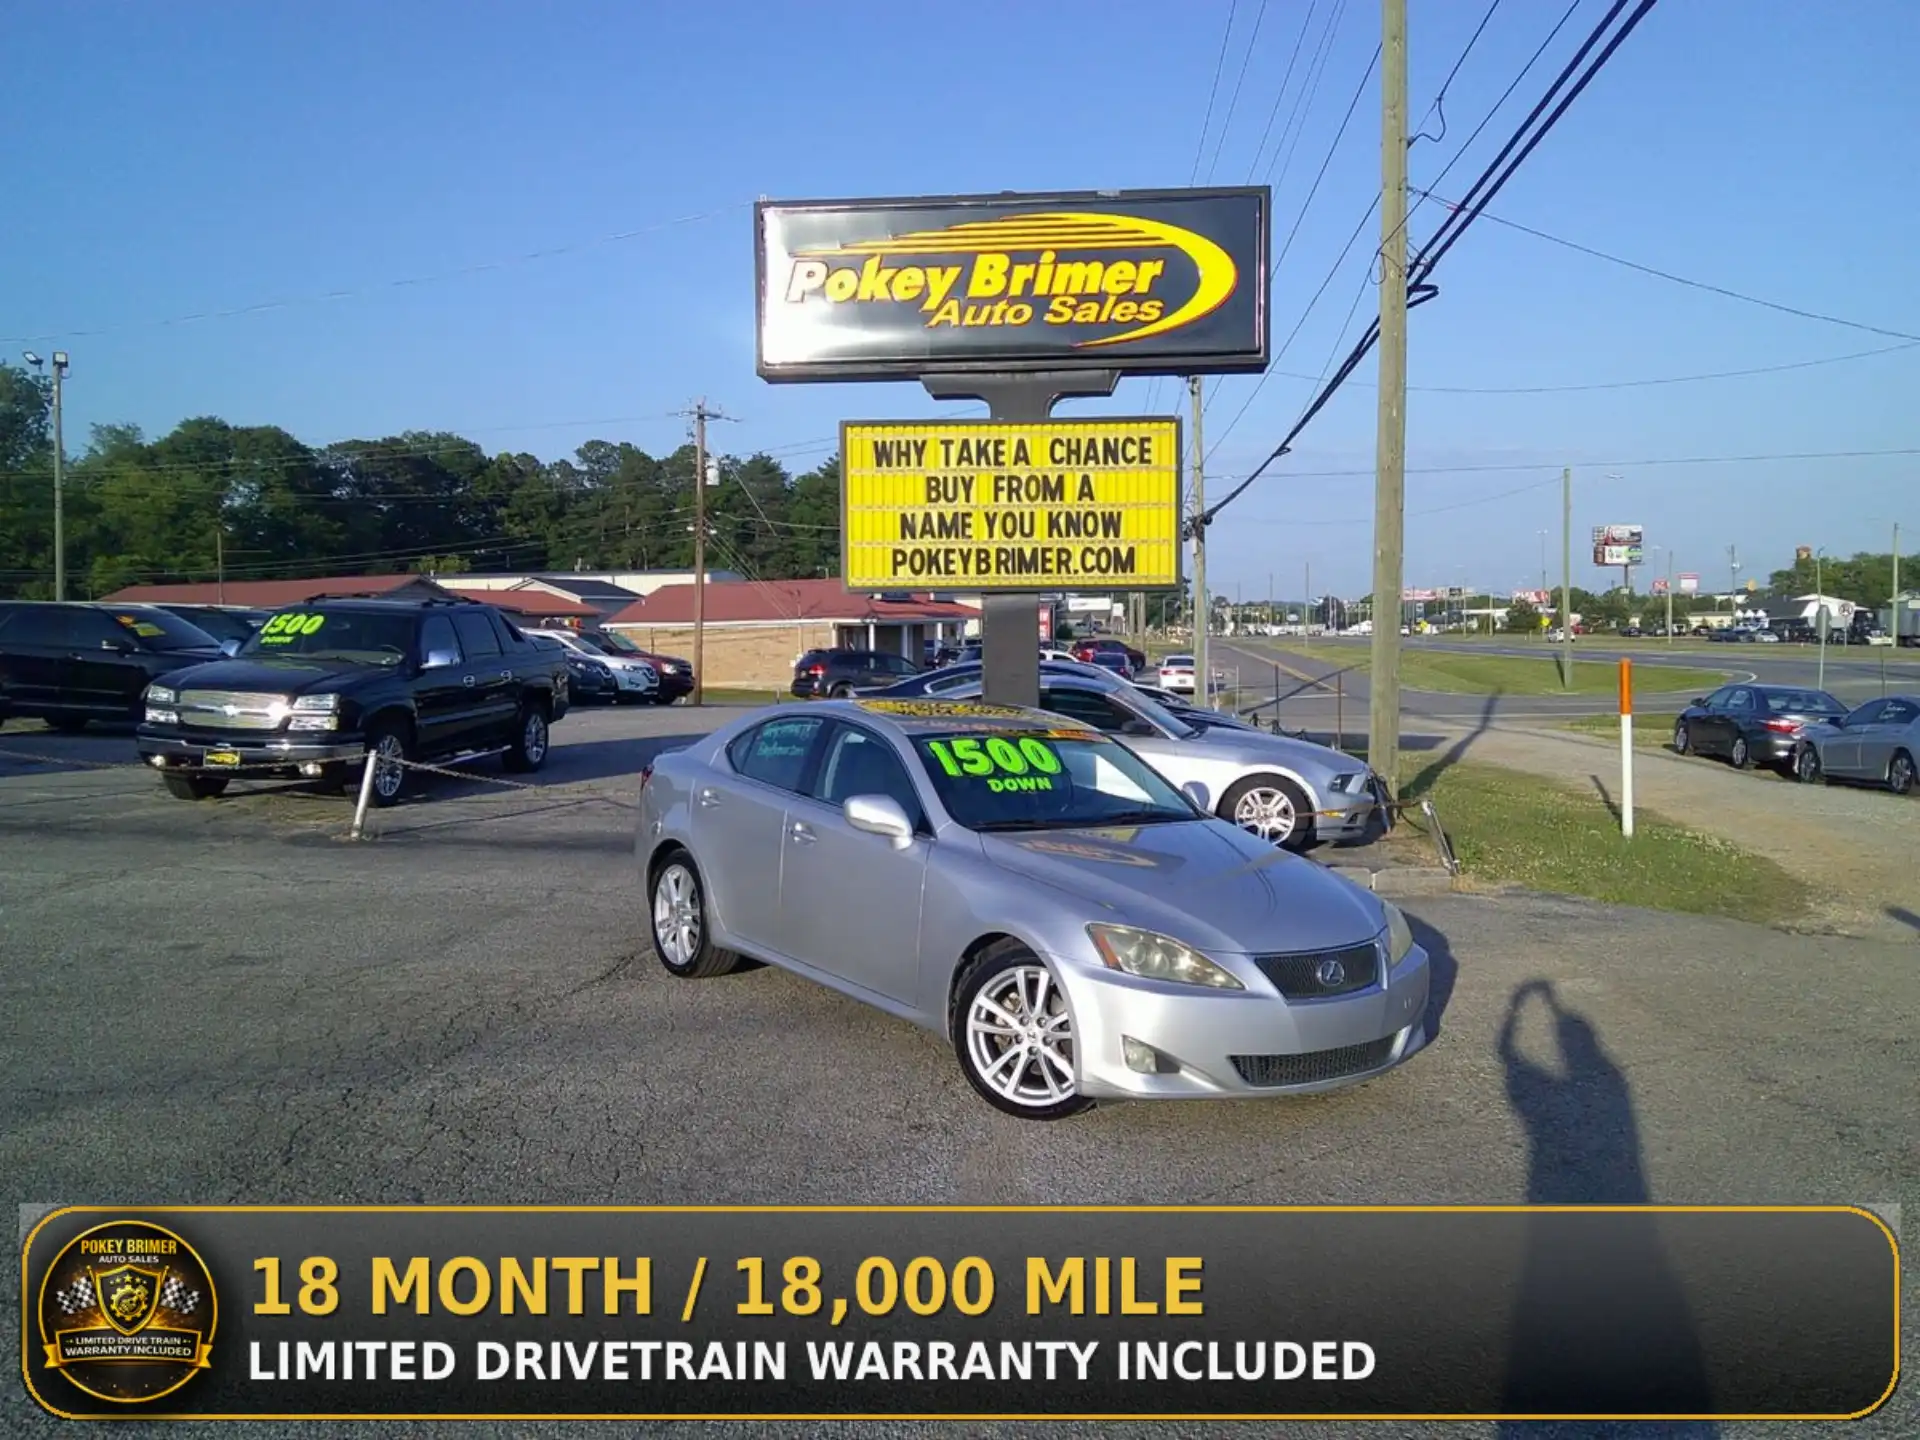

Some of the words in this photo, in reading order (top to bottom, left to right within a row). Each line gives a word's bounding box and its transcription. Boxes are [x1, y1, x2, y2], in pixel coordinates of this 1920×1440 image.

[785, 255, 962, 312] Pokey
[967, 249, 1164, 300] Brimer
[928, 299, 1032, 328] Auto
[1043, 294, 1164, 325] Sales
[873, 439, 928, 468] WHY
[940, 438, 1006, 467] TAKE
[1013, 438, 1031, 466] A
[1049, 436, 1152, 466] CHANCE
[926, 475, 975, 503] BUY
[993, 474, 1065, 503] FROM
[1077, 474, 1095, 502] A
[900, 511, 973, 540] NAME
[984, 511, 1035, 539] YOU
[1048, 510, 1122, 539] KNOW
[892, 546, 1135, 576] POKEYBRIMER.COM
[260, 613, 324, 634] 1500
[928, 737, 1062, 776] 1500
[986, 776, 1053, 793] DOWN
